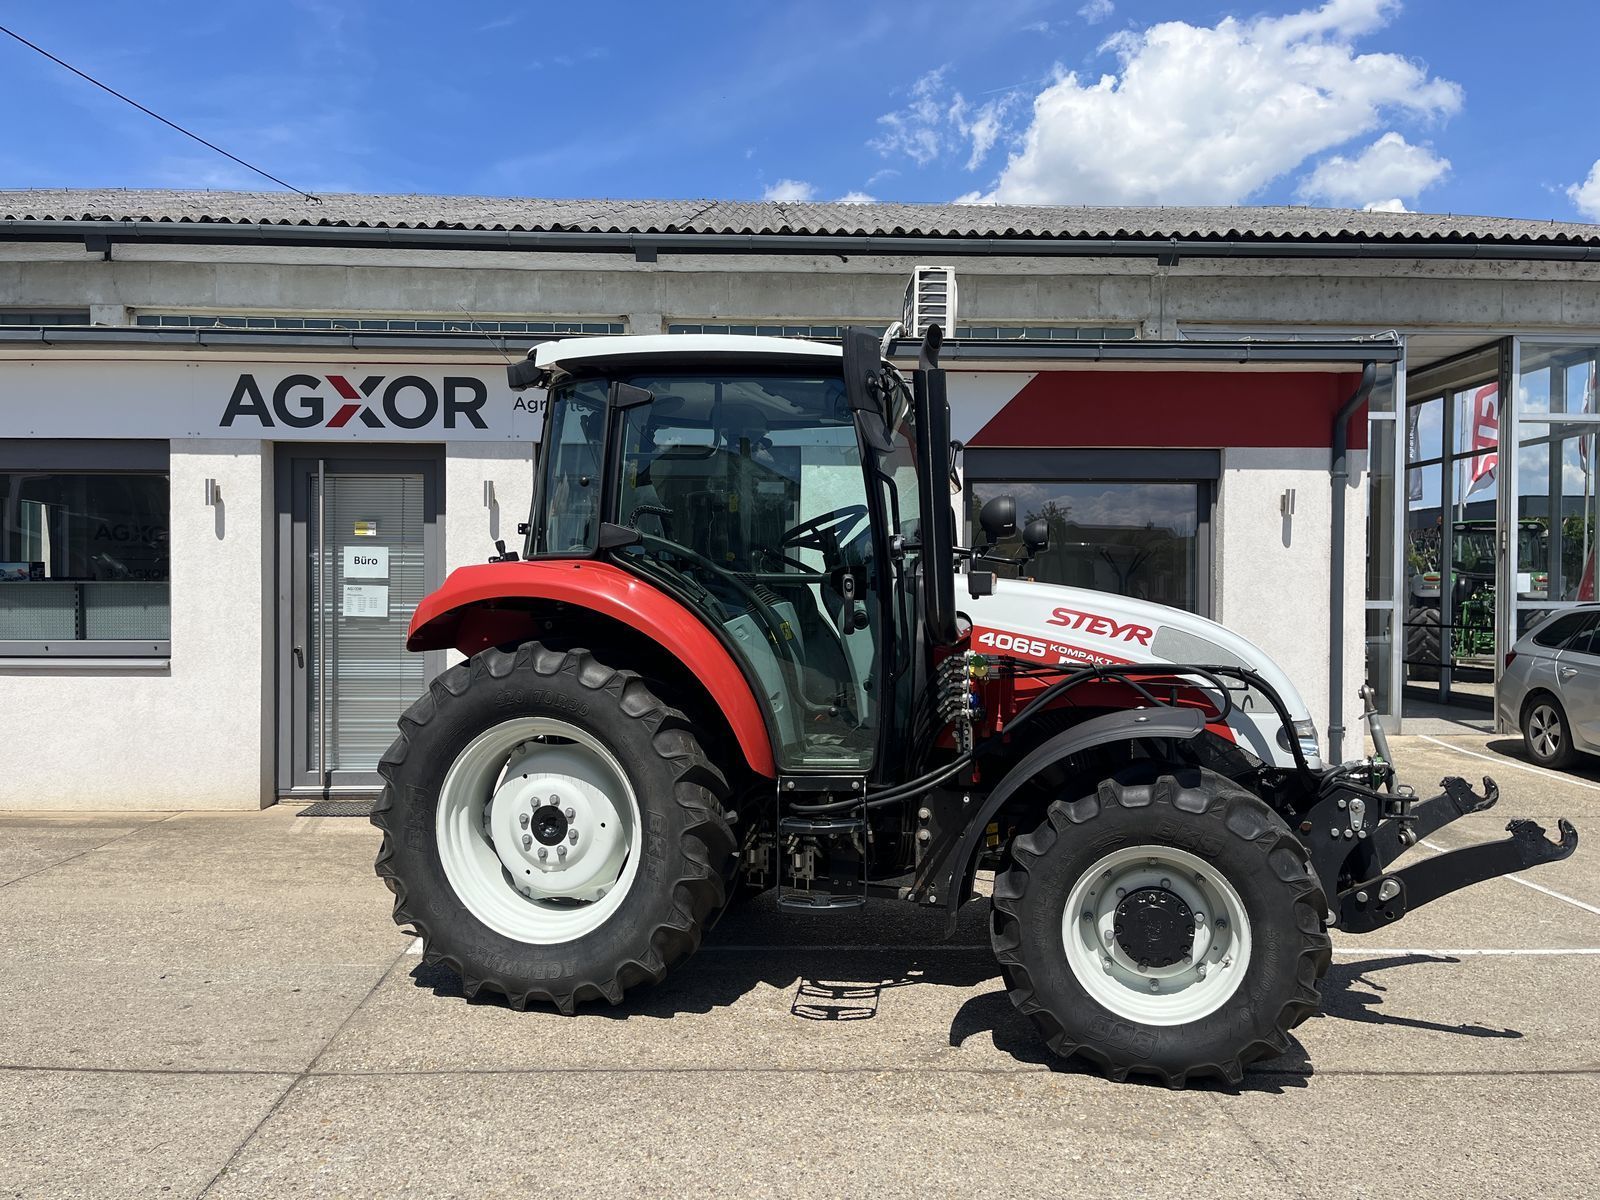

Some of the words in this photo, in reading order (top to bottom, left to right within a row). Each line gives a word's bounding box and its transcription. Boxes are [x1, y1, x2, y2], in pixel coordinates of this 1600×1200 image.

[220, 373, 489, 429] AGXOR
[354, 555, 378, 565] Büro
[1046, 607, 1153, 647] STEYR
[978, 631, 1047, 658] 4065
[1049, 644, 1114, 665] KOMPAKT
